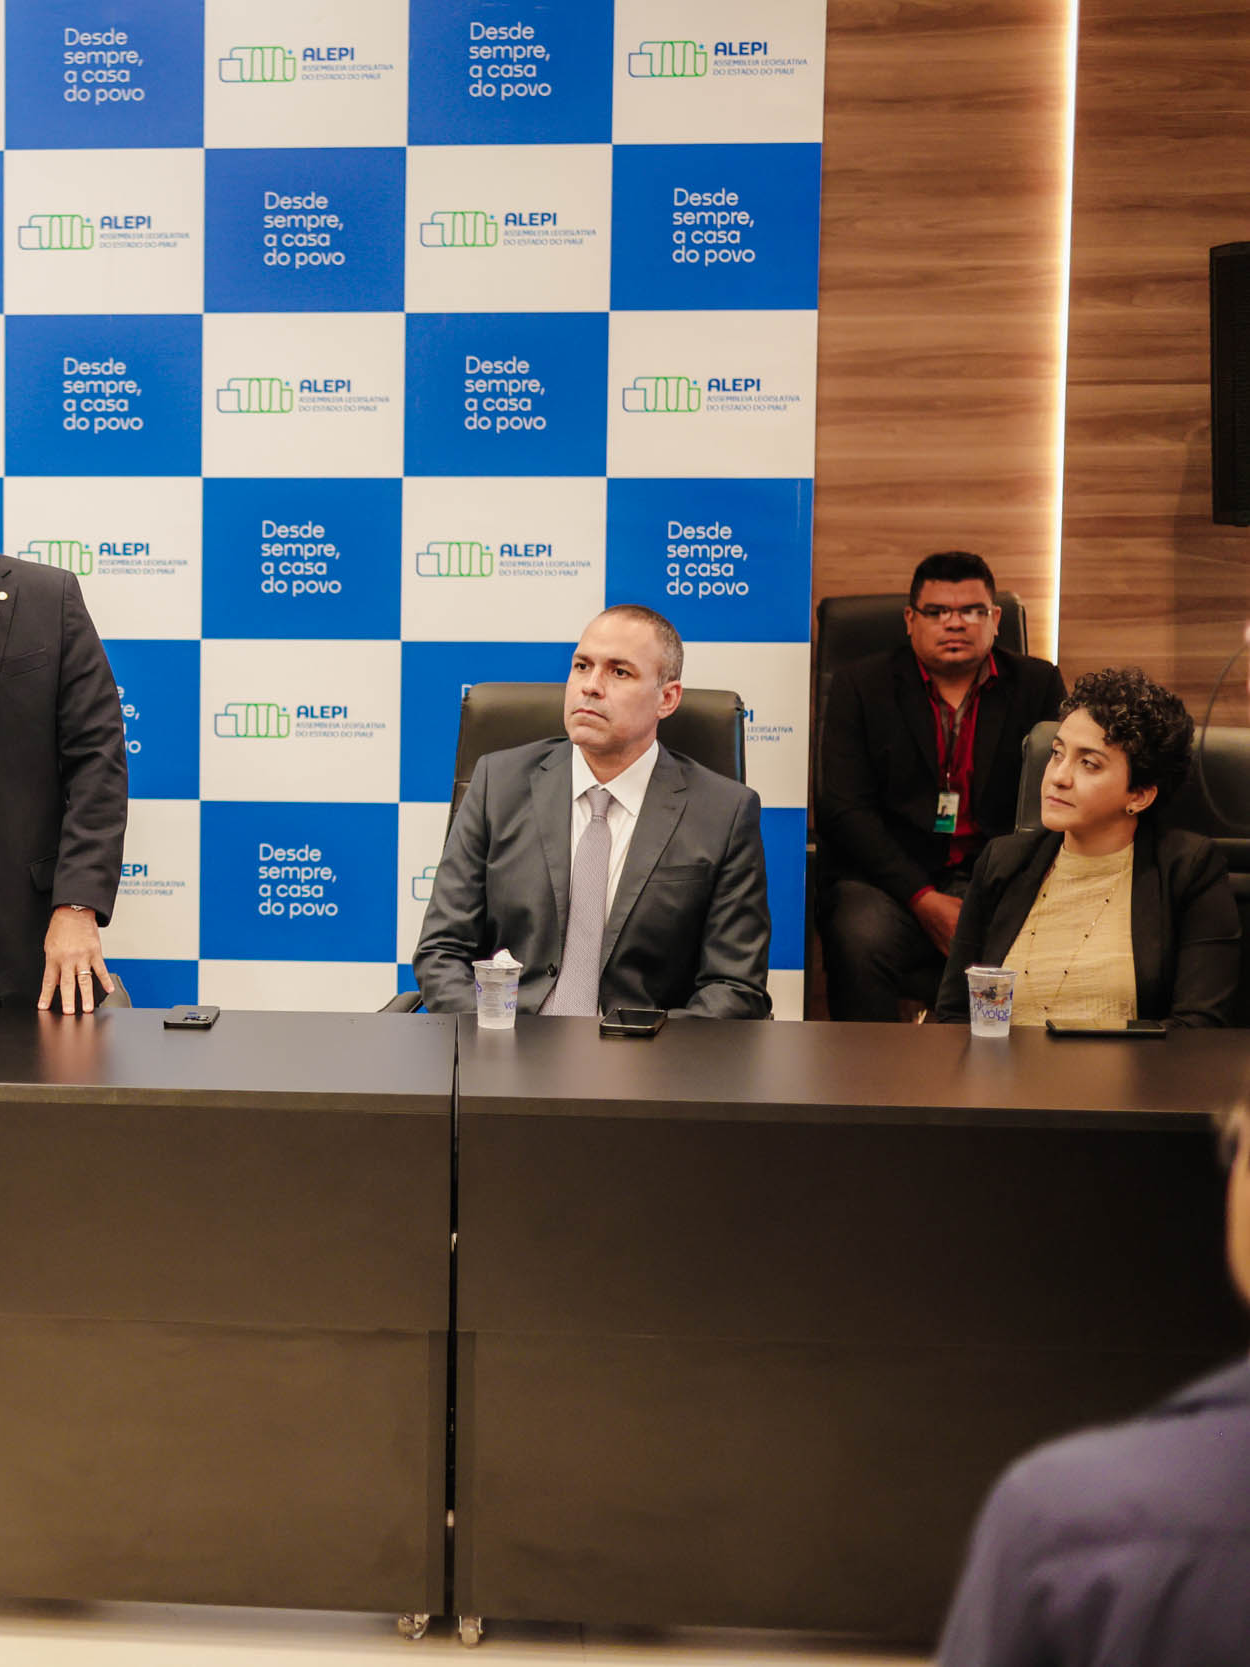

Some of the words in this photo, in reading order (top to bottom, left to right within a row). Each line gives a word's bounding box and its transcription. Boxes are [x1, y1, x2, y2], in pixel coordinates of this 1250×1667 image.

[64, 28, 128, 46] Desde
[470, 21, 534, 40] Desde
[303, 47, 354, 61] ALEPI
[469, 45, 550, 62] sempre,
[714, 42, 767, 56] ALEPI
[64, 50, 143, 68] sempre,
[64, 70, 77, 83] a
[82, 70, 130, 83] casa
[469, 64, 483, 78] a
[487, 64, 537, 78] casa
[64, 84, 91, 102] do
[95, 88, 145, 105] povo
[468, 79, 496, 97] do
[501, 83, 552, 101] povo
[264, 191, 328, 210] Desde
[674, 188, 739, 206] Desde
[100, 216, 151, 230] ALEPI
[264, 214, 344, 232] sempre,
[505, 212, 557, 226] ALEPI
[673, 211, 754, 229] sempre,
[264, 234, 277, 247] a
[282, 233, 330, 247] casa
[672, 230, 686, 244] a
[691, 230, 741, 244] casa
[264, 248, 291, 266] do
[295, 252, 345, 269] povo
[672, 245, 700, 263] do
[704, 249, 756, 266] povo
[64, 357, 126, 375] Desde
[465, 356, 530, 374] Desde
[63, 380, 142, 397] sempre,
[300, 379, 351, 393] ALEPI
[464, 379, 545, 396] sempre,
[708, 378, 760, 392] ALEPI
[63, 399, 76, 412] a
[80, 398, 129, 412] casa
[464, 398, 478, 412] a
[482, 398, 532, 412] casa
[63, 413, 90, 430] do
[94, 417, 144, 434] povo
[464, 412, 492, 430] do
[496, 416, 546, 434] povo
[262, 520, 325, 539] Desde
[668, 521, 732, 540] Desde
[99, 542, 149, 556] ALEPI
[261, 543, 340, 560] sempre,
[500, 544, 552, 557] ALEPI
[667, 544, 748, 562] sempre,
[261, 562, 274, 575] a
[278, 562, 327, 575] casa
[666, 563, 680, 577] a
[685, 563, 734, 577] casa
[261, 576, 288, 594] do
[292, 580, 342, 597] povo
[666, 577, 694, 596] do
[698, 582, 749, 599] povo
[297, 705, 347, 719] ALEPI
[259, 843, 322, 862] Desde
[121, 863, 147, 877] EPI
[258, 866, 336, 883] sempre,
[258, 884, 271, 897] a
[276, 884, 324, 898] casa
[258, 898, 285, 916] do
[289, 902, 338, 919] povo
